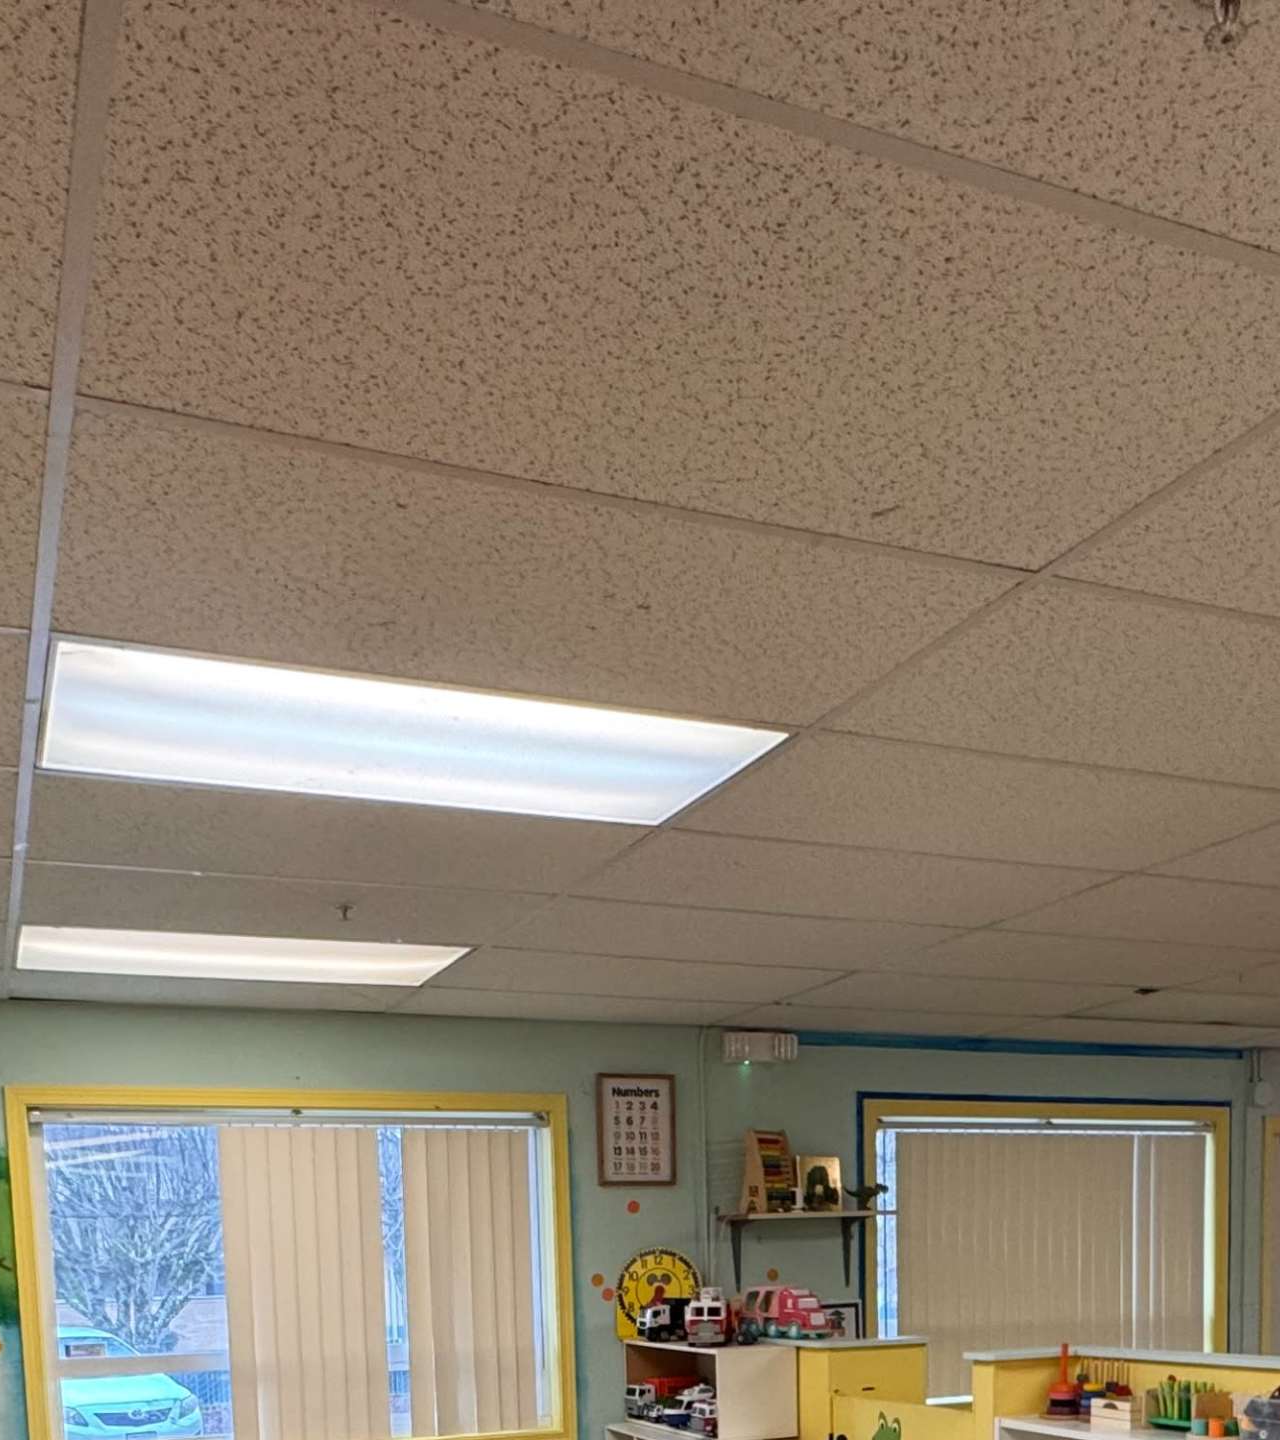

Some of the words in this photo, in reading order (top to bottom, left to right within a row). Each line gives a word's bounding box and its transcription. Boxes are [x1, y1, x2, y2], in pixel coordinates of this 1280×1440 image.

[612, 1086, 661, 1098] Numbers
[626, 1101, 633, 1110] 2
[639, 1101, 646, 1111] 3
[650, 1101, 658, 1110] 4
[614, 1116, 621, 1125] 5
[626, 1116, 634, 1126] 6
[639, 1116, 646, 1125] 7
[654, 1255, 663, 1265] 12
[628, 1271, 639, 1281] 10
[623, 1286, 630, 1296] 9
